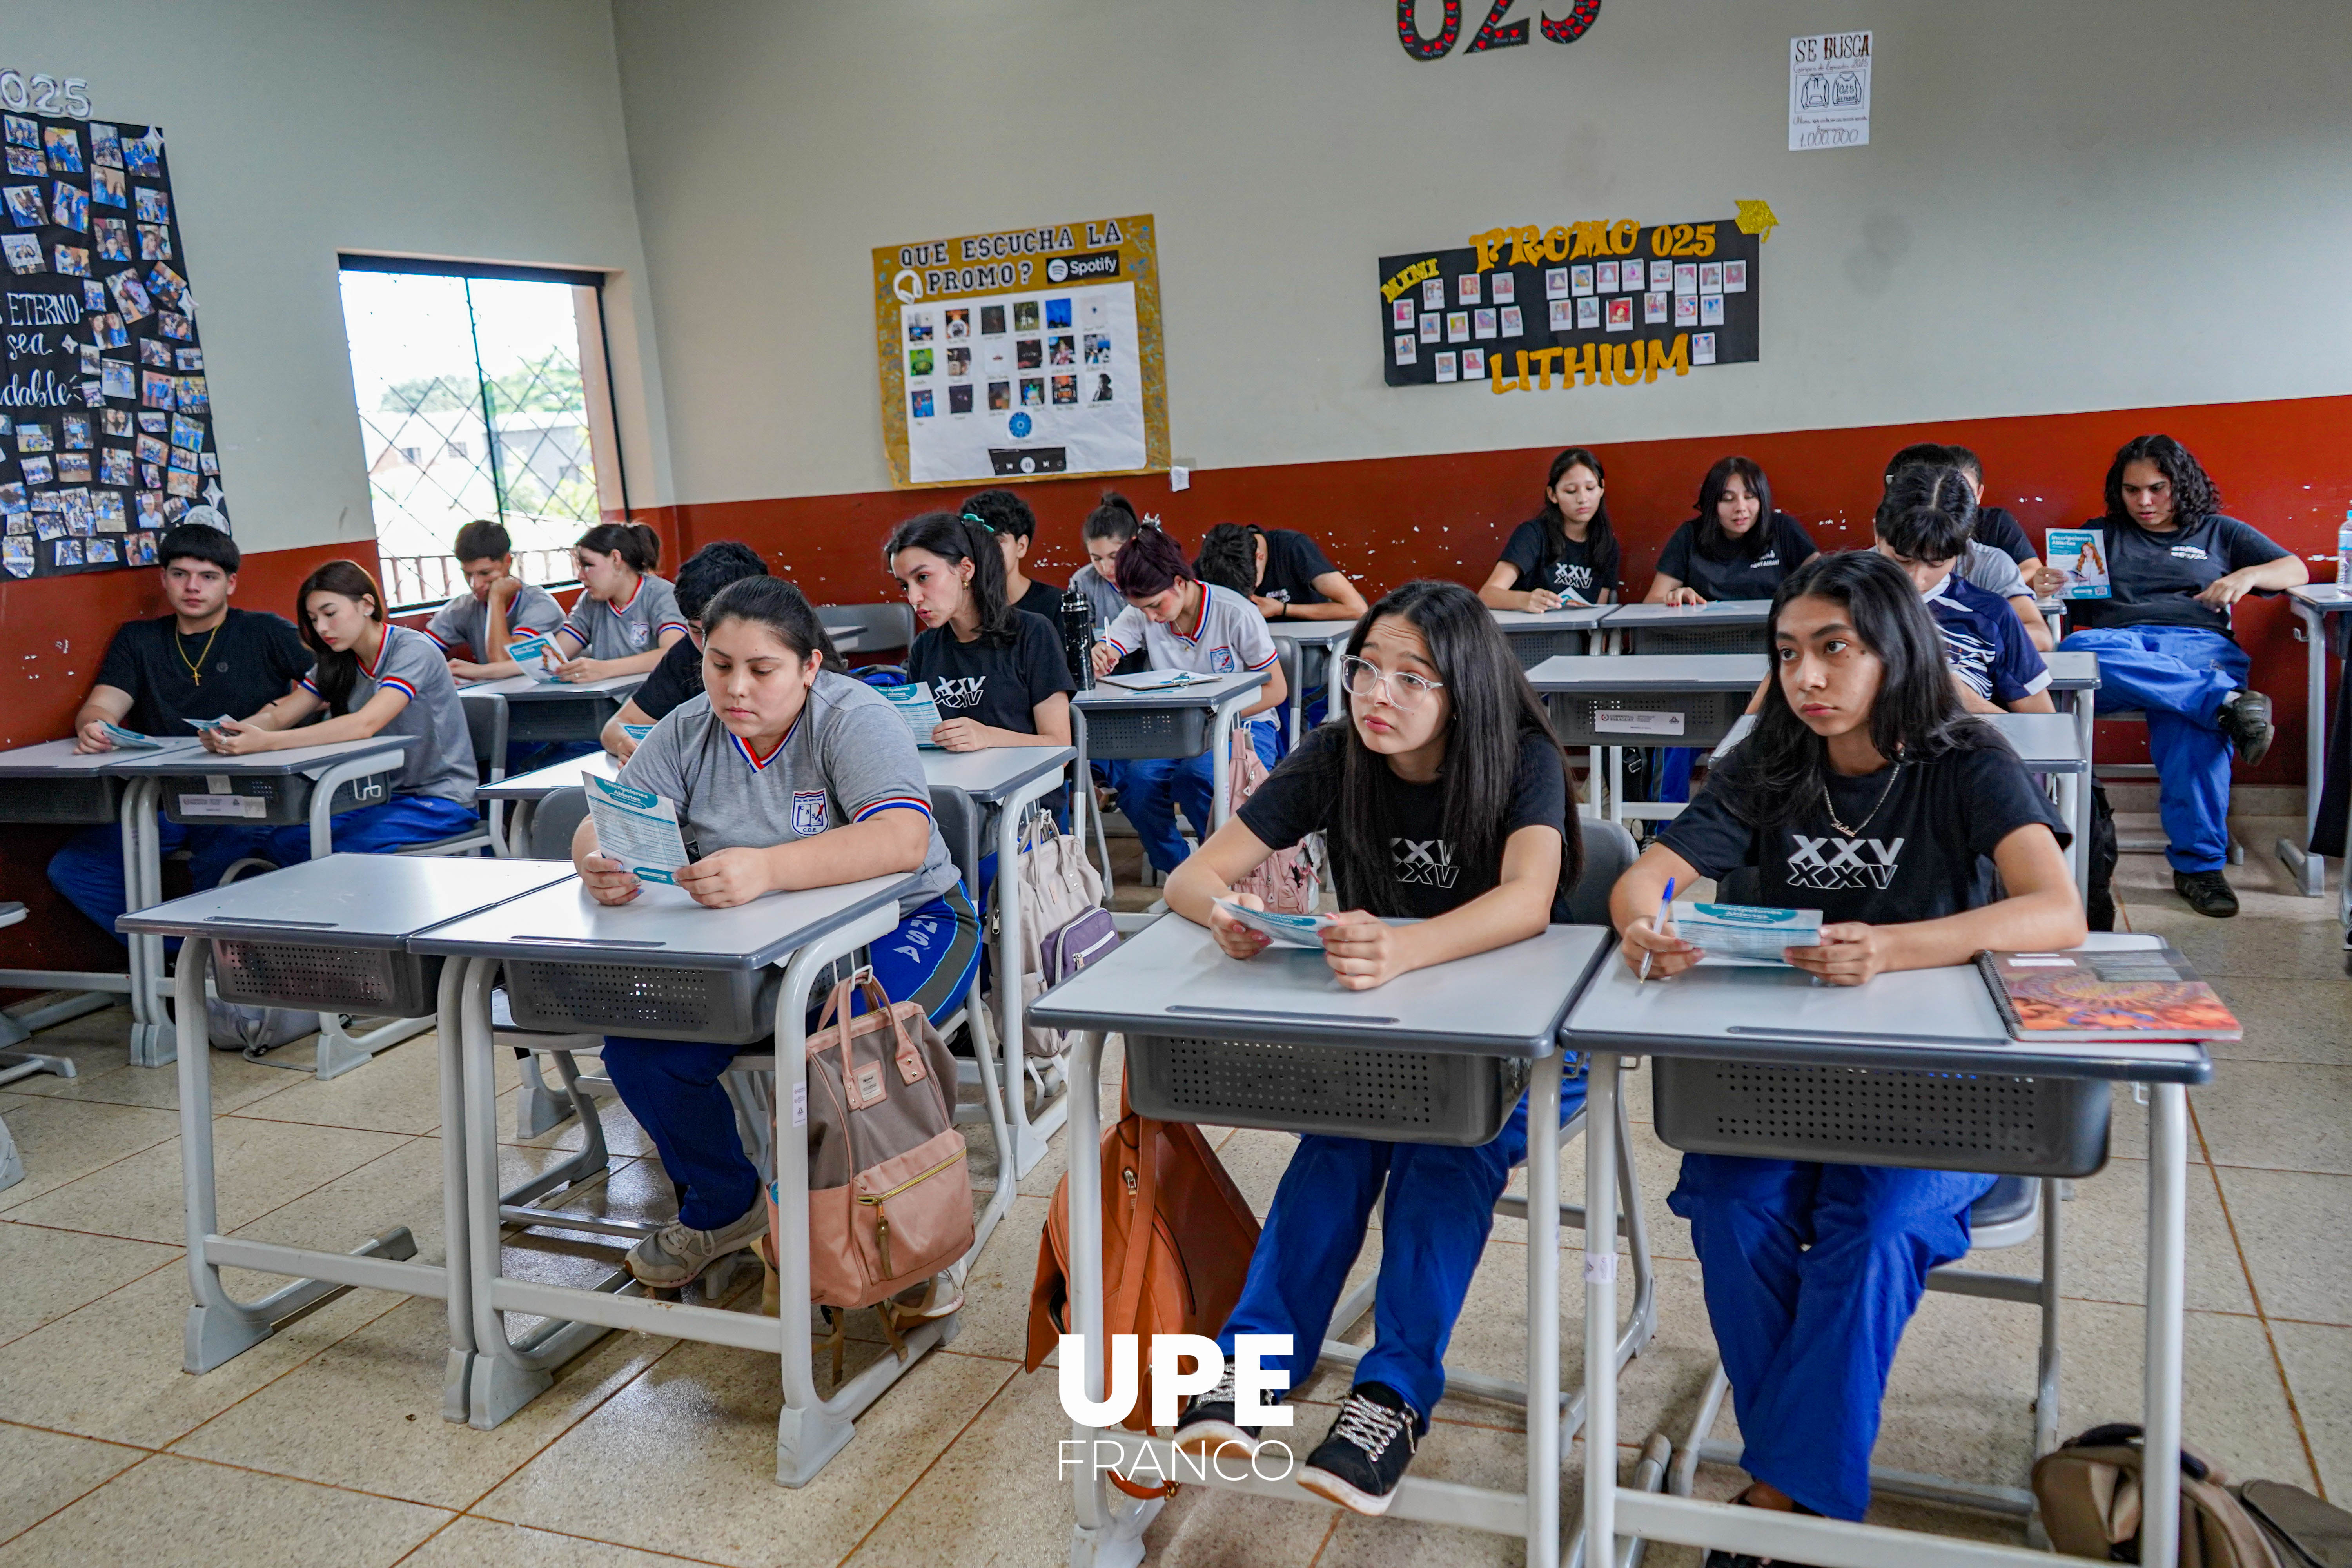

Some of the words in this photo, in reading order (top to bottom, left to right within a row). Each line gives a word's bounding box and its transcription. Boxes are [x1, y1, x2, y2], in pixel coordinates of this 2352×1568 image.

[1795, 39, 1817, 63] SE
[1824, 34, 1871, 60] BUSCA
[0, 67, 93, 120] 025
[901, 243, 948, 268] QUE
[964, 227, 1074, 260] ESCUCHA
[1087, 220, 1122, 246] LA
[1470, 219, 1641, 274] PROMO
[1651, 224, 1716, 257] 025
[927, 261, 1033, 292] PROMO?
[1070, 257, 1117, 276] Spotify
[1380, 258, 1440, 304] MINI
[7, 332, 53, 360] sea
[1489, 333, 1688, 394] LITHIUM
[1555, 563, 1592, 579] XXV
[604, 780, 648, 799] Inscripciones
[614, 789, 641, 802] Abiertas
[1787, 835, 1905, 866] XXV
[1786, 861, 1898, 889] XXV
